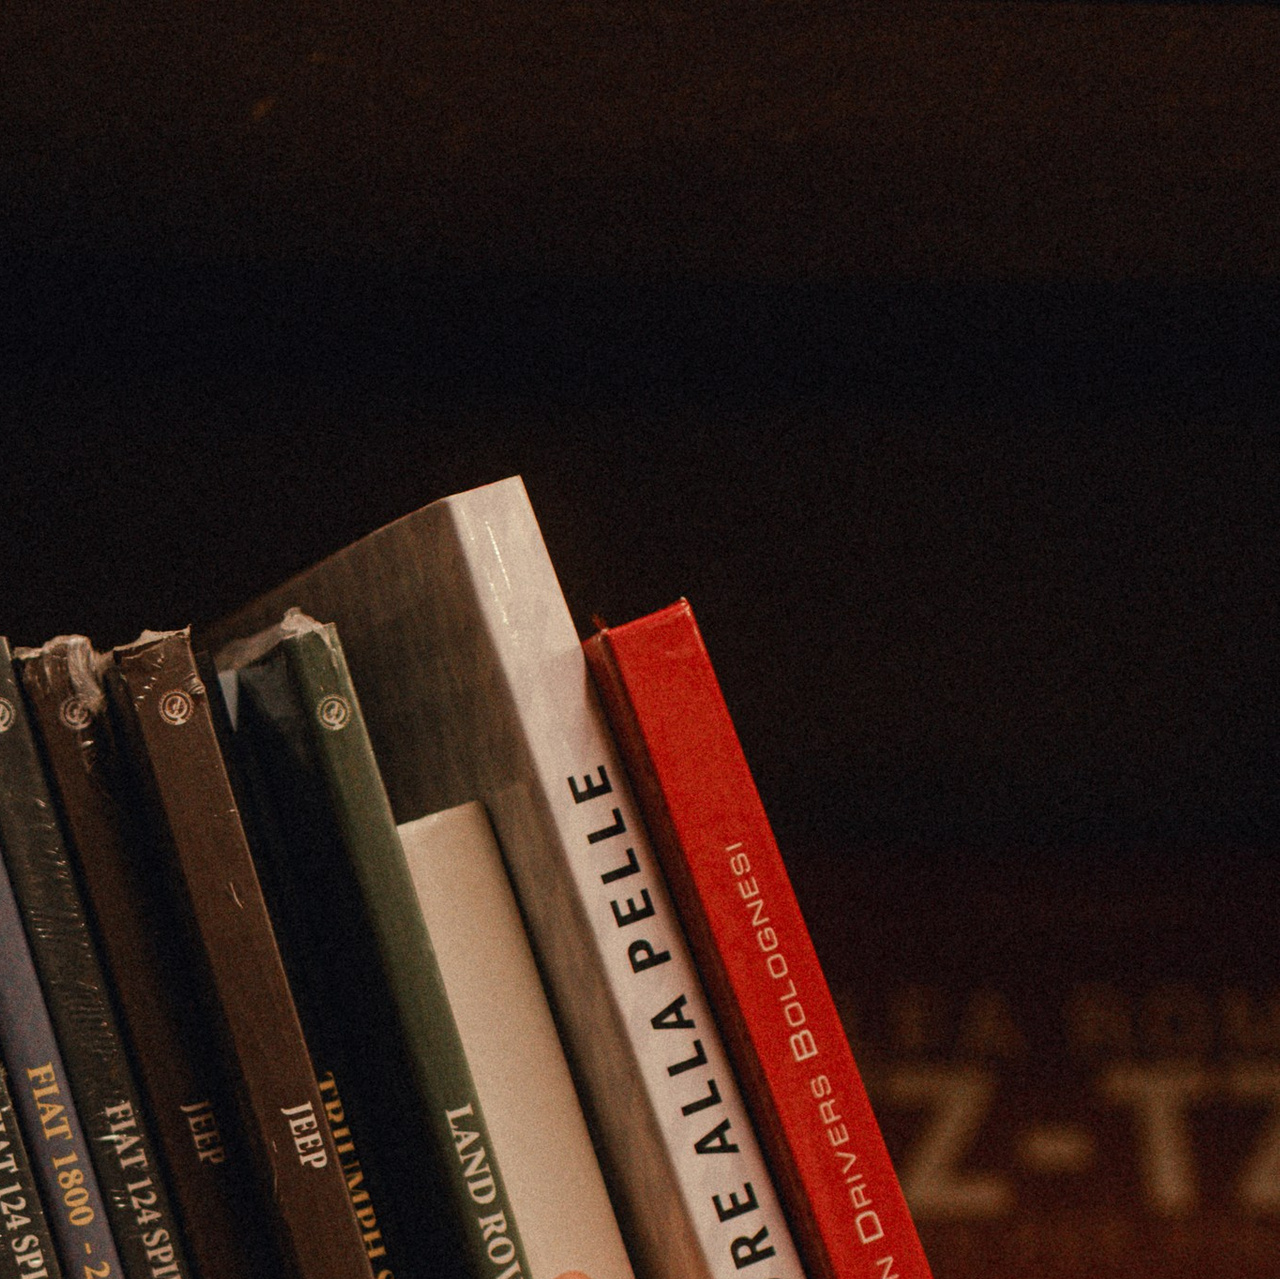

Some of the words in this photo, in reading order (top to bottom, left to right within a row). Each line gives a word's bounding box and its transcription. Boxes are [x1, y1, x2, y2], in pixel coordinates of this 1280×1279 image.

[566, 764, 672, 974] PELLE
[725, 841, 818, 1064] BOLOGNESI
[27, 1062, 73, 1141] FIAT
[52, 1152, 95, 1227] 1800
[180, 1101, 226, 1165] JEEP
[280, 1100, 328, 1169] JEEP
[445, 1103, 498, 1205] LAND
[650, 992, 740, 1157] ALLA
[106, 1101, 146, 1168] FIAT
[128, 1178, 162, 1225] 124
[810, 1074, 886, 1246] DRIVERS
